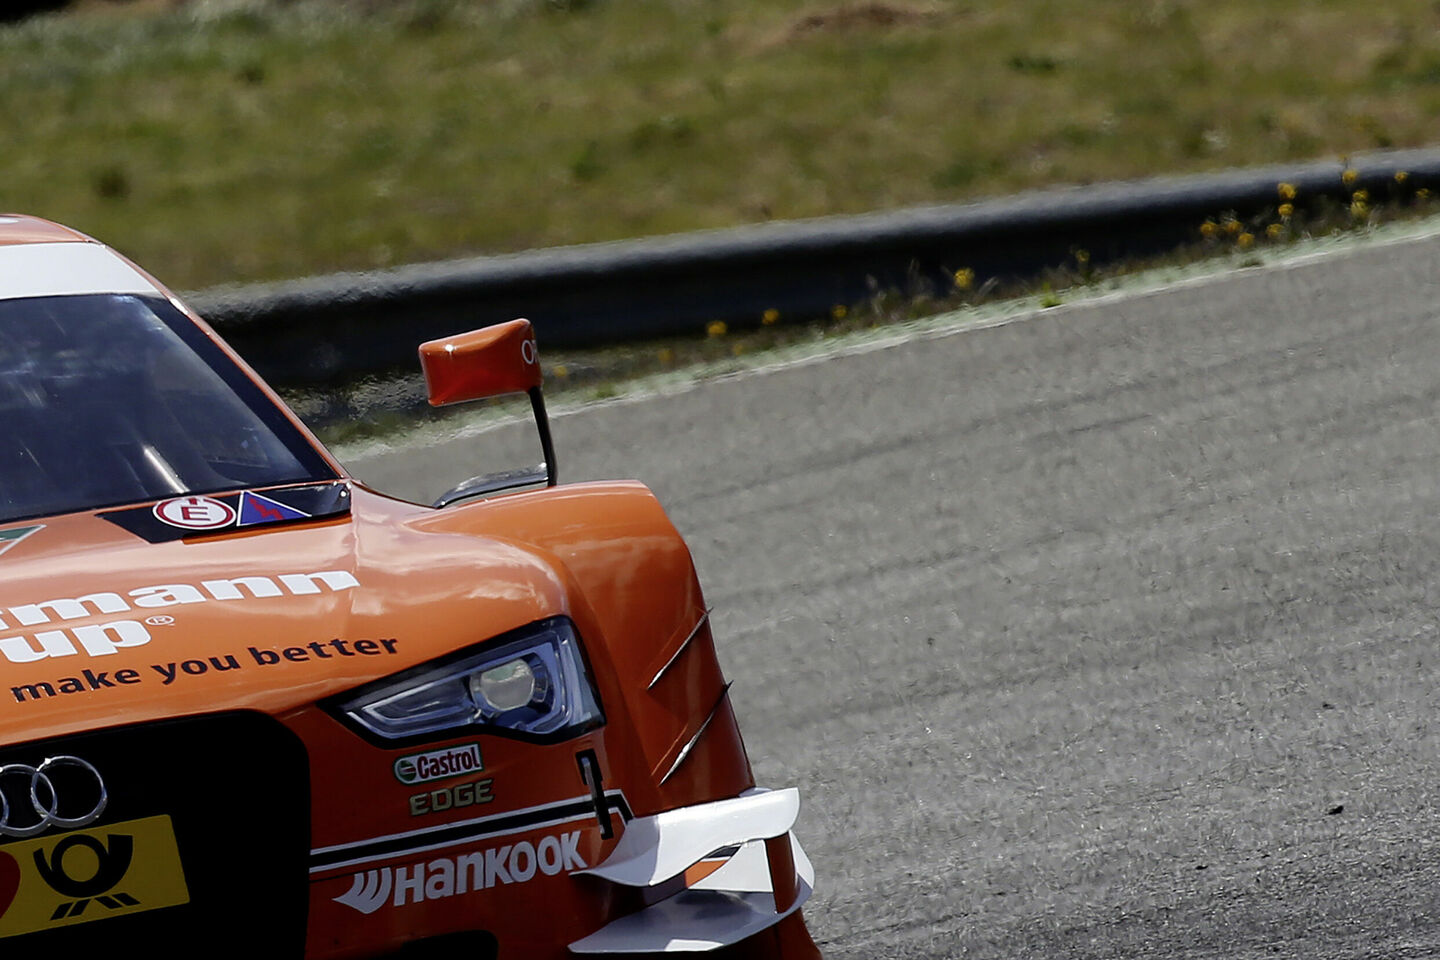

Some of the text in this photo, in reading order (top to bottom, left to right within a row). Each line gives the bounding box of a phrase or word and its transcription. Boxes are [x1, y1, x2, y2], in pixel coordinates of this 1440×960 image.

[10, 668, 142, 703] make
[151, 653, 241, 686] you
[247, 637, 399, 666] better
[416, 746, 481, 780] Castrol
[409, 778, 495, 816] EDGE
